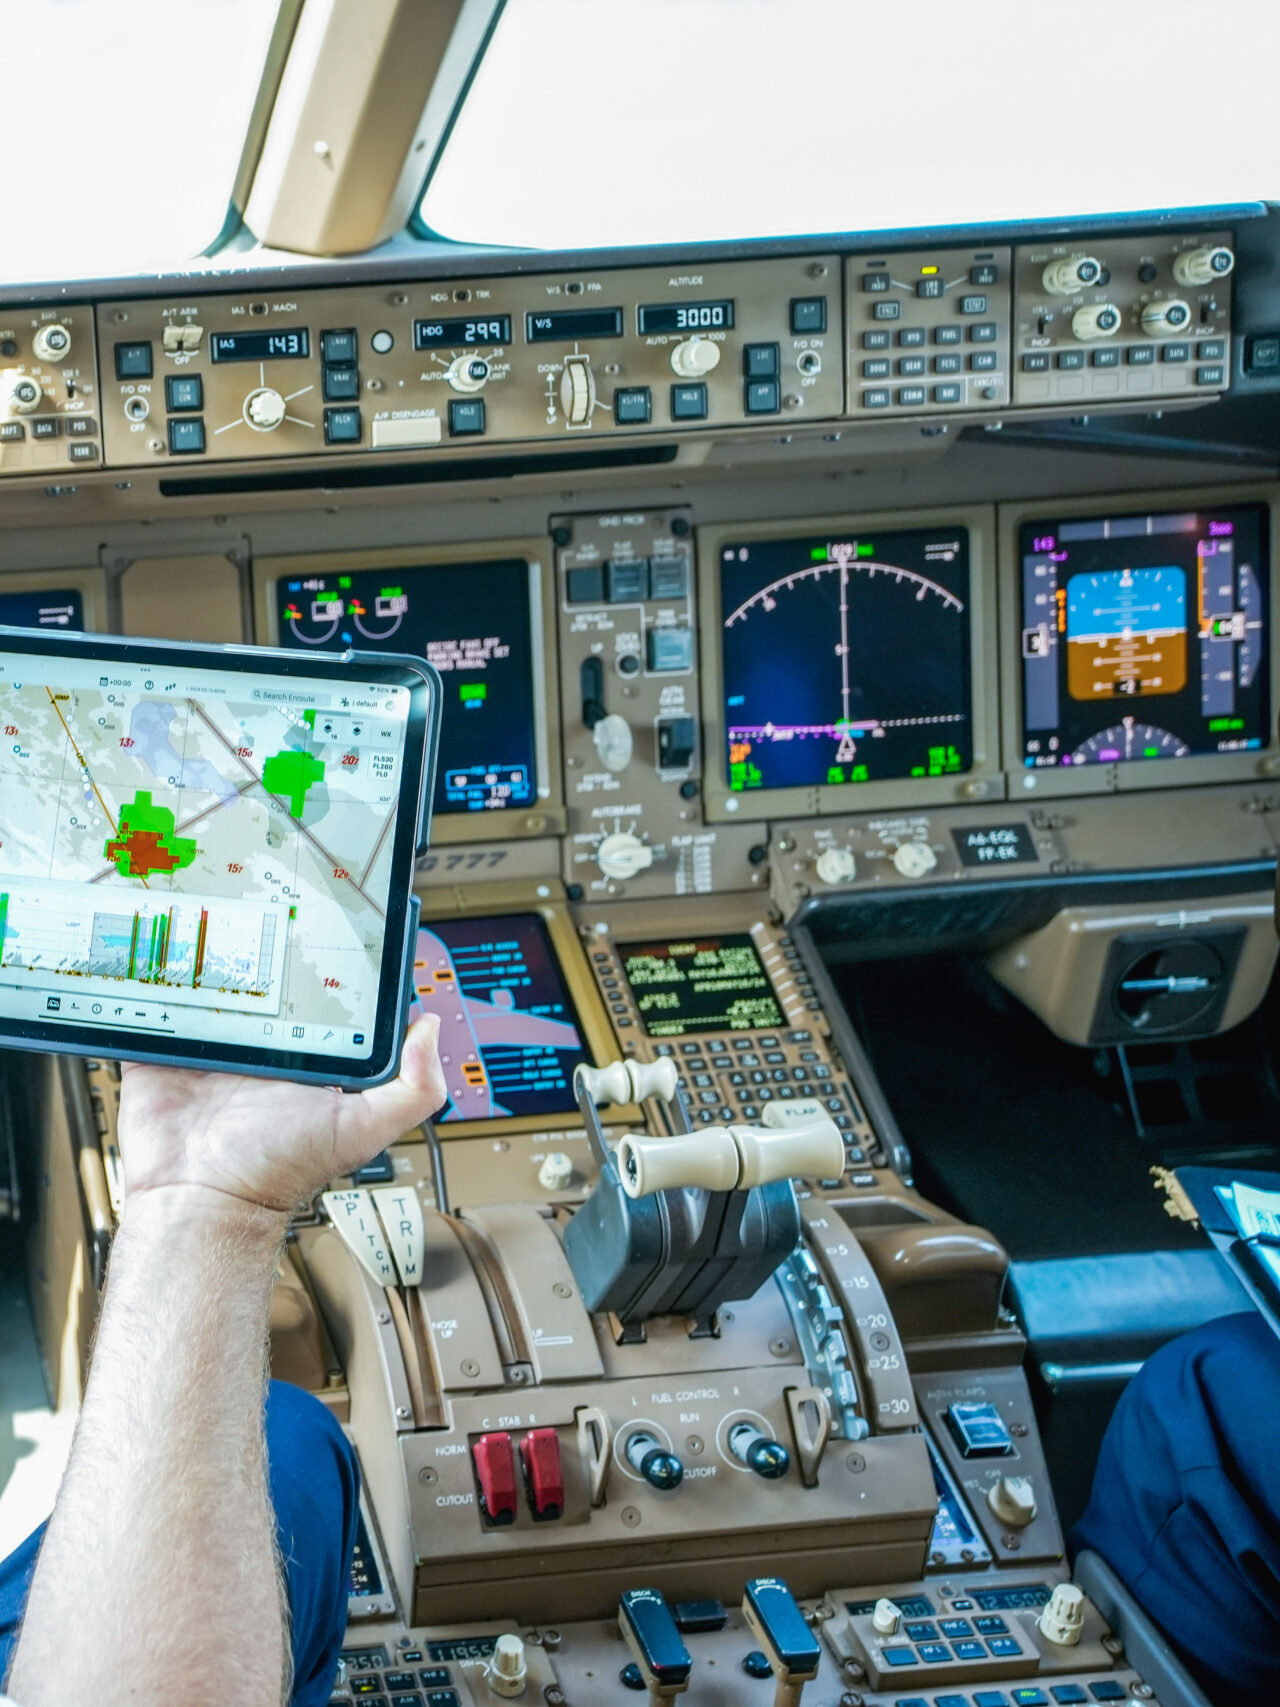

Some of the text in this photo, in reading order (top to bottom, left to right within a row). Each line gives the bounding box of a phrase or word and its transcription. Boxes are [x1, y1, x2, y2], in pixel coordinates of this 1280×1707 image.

[669, 276, 703, 286] ALTITUDE
[546, 283, 602, 295] V/S FPA
[162, 307, 197, 317] A/T ARM
[232, 304, 297, 315] IAS MACH
[677, 307, 723, 327] 3000
[535, 319, 552, 329] V/S
[422, 322, 500, 341] HDG 299
[943, 331, 956, 339] FUEL
[1195, 327, 1214, 335] INOP
[220, 335, 299, 354] IAS 143
[646, 337, 667, 345] AUTO
[871, 336, 885, 344] ELEC
[794, 341, 807, 349] F/D
[175, 357, 190, 365] OFF
[538, 364, 563, 373] DOWN
[870, 364, 886, 372] DOOR
[421, 372, 441, 380] AUTO
[802, 378, 816, 387] OFF
[121, 385, 151, 394] F/D ON
[375, 409, 436, 420] A/P DISENGAGE
[546, 415, 557, 424] UP
[73, 422, 86, 430] POS
[2, 427, 16, 435] ARPT
[74, 447, 89, 456] TERR
[263, 692, 315, 703] Search Enroute
[356, 700, 378, 708] default
[733, 1075, 742, 1083] A
[775, 1071, 784, 1080] C
[822, 1219, 828, 1228] 1
[346, 1202, 390, 1273] PITCH
[393, 1198, 416, 1274] TRIM
[839, 1245, 848, 1255] 5
[854, 1277, 869, 1289] 15
[432, 1320, 458, 1329] NOSE
[869, 1314, 886, 1328] 20
[442, 1330, 452, 1338] UP
[532, 1329, 543, 1338] UP
[881, 1355, 899, 1369] 25
[652, 1393, 673, 1402] FUEL
[676, 1389, 719, 1400] CONTROL
[734, 1387, 739, 1395] R
[890, 1400, 909, 1413] 30
[483, 1414, 535, 1428] C STAB R
[680, 1413, 699, 1423] RUN
[436, 1446, 467, 1455] NORM
[684, 1468, 717, 1479] CUTOFF
[436, 1495, 473, 1506] CUTOUT
[631, 1590, 651, 1598] DISCH
